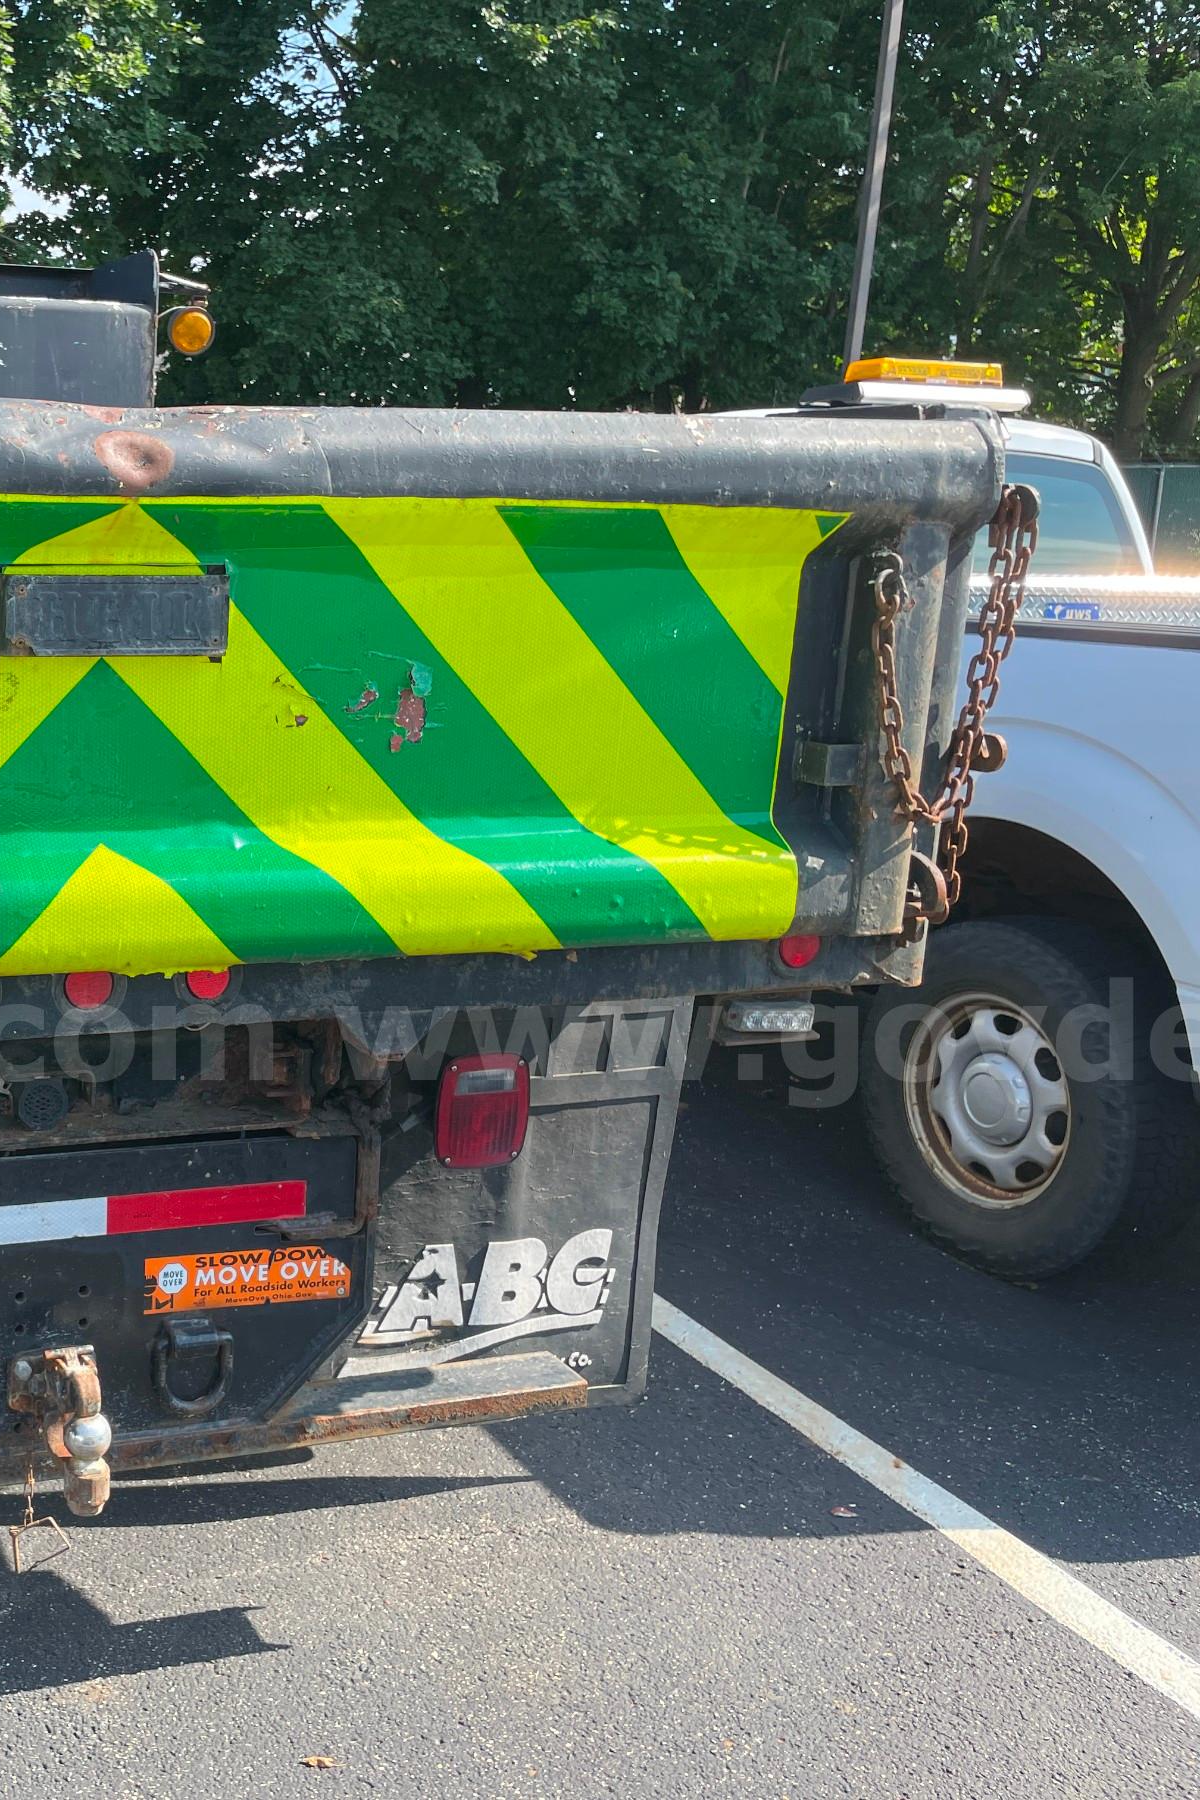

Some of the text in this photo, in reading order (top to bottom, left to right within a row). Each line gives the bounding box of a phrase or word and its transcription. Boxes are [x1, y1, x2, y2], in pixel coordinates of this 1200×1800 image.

[195, 1248, 334, 1268] SLOW DOW
[162, 1270, 185, 1279] MOVE
[162, 1278, 183, 1287] OVER
[194, 1258, 346, 1287] MOVE OVER
[376, 1228, 613, 1333] ABC
[193, 1277, 346, 1297] For ALL Roadside Workers
